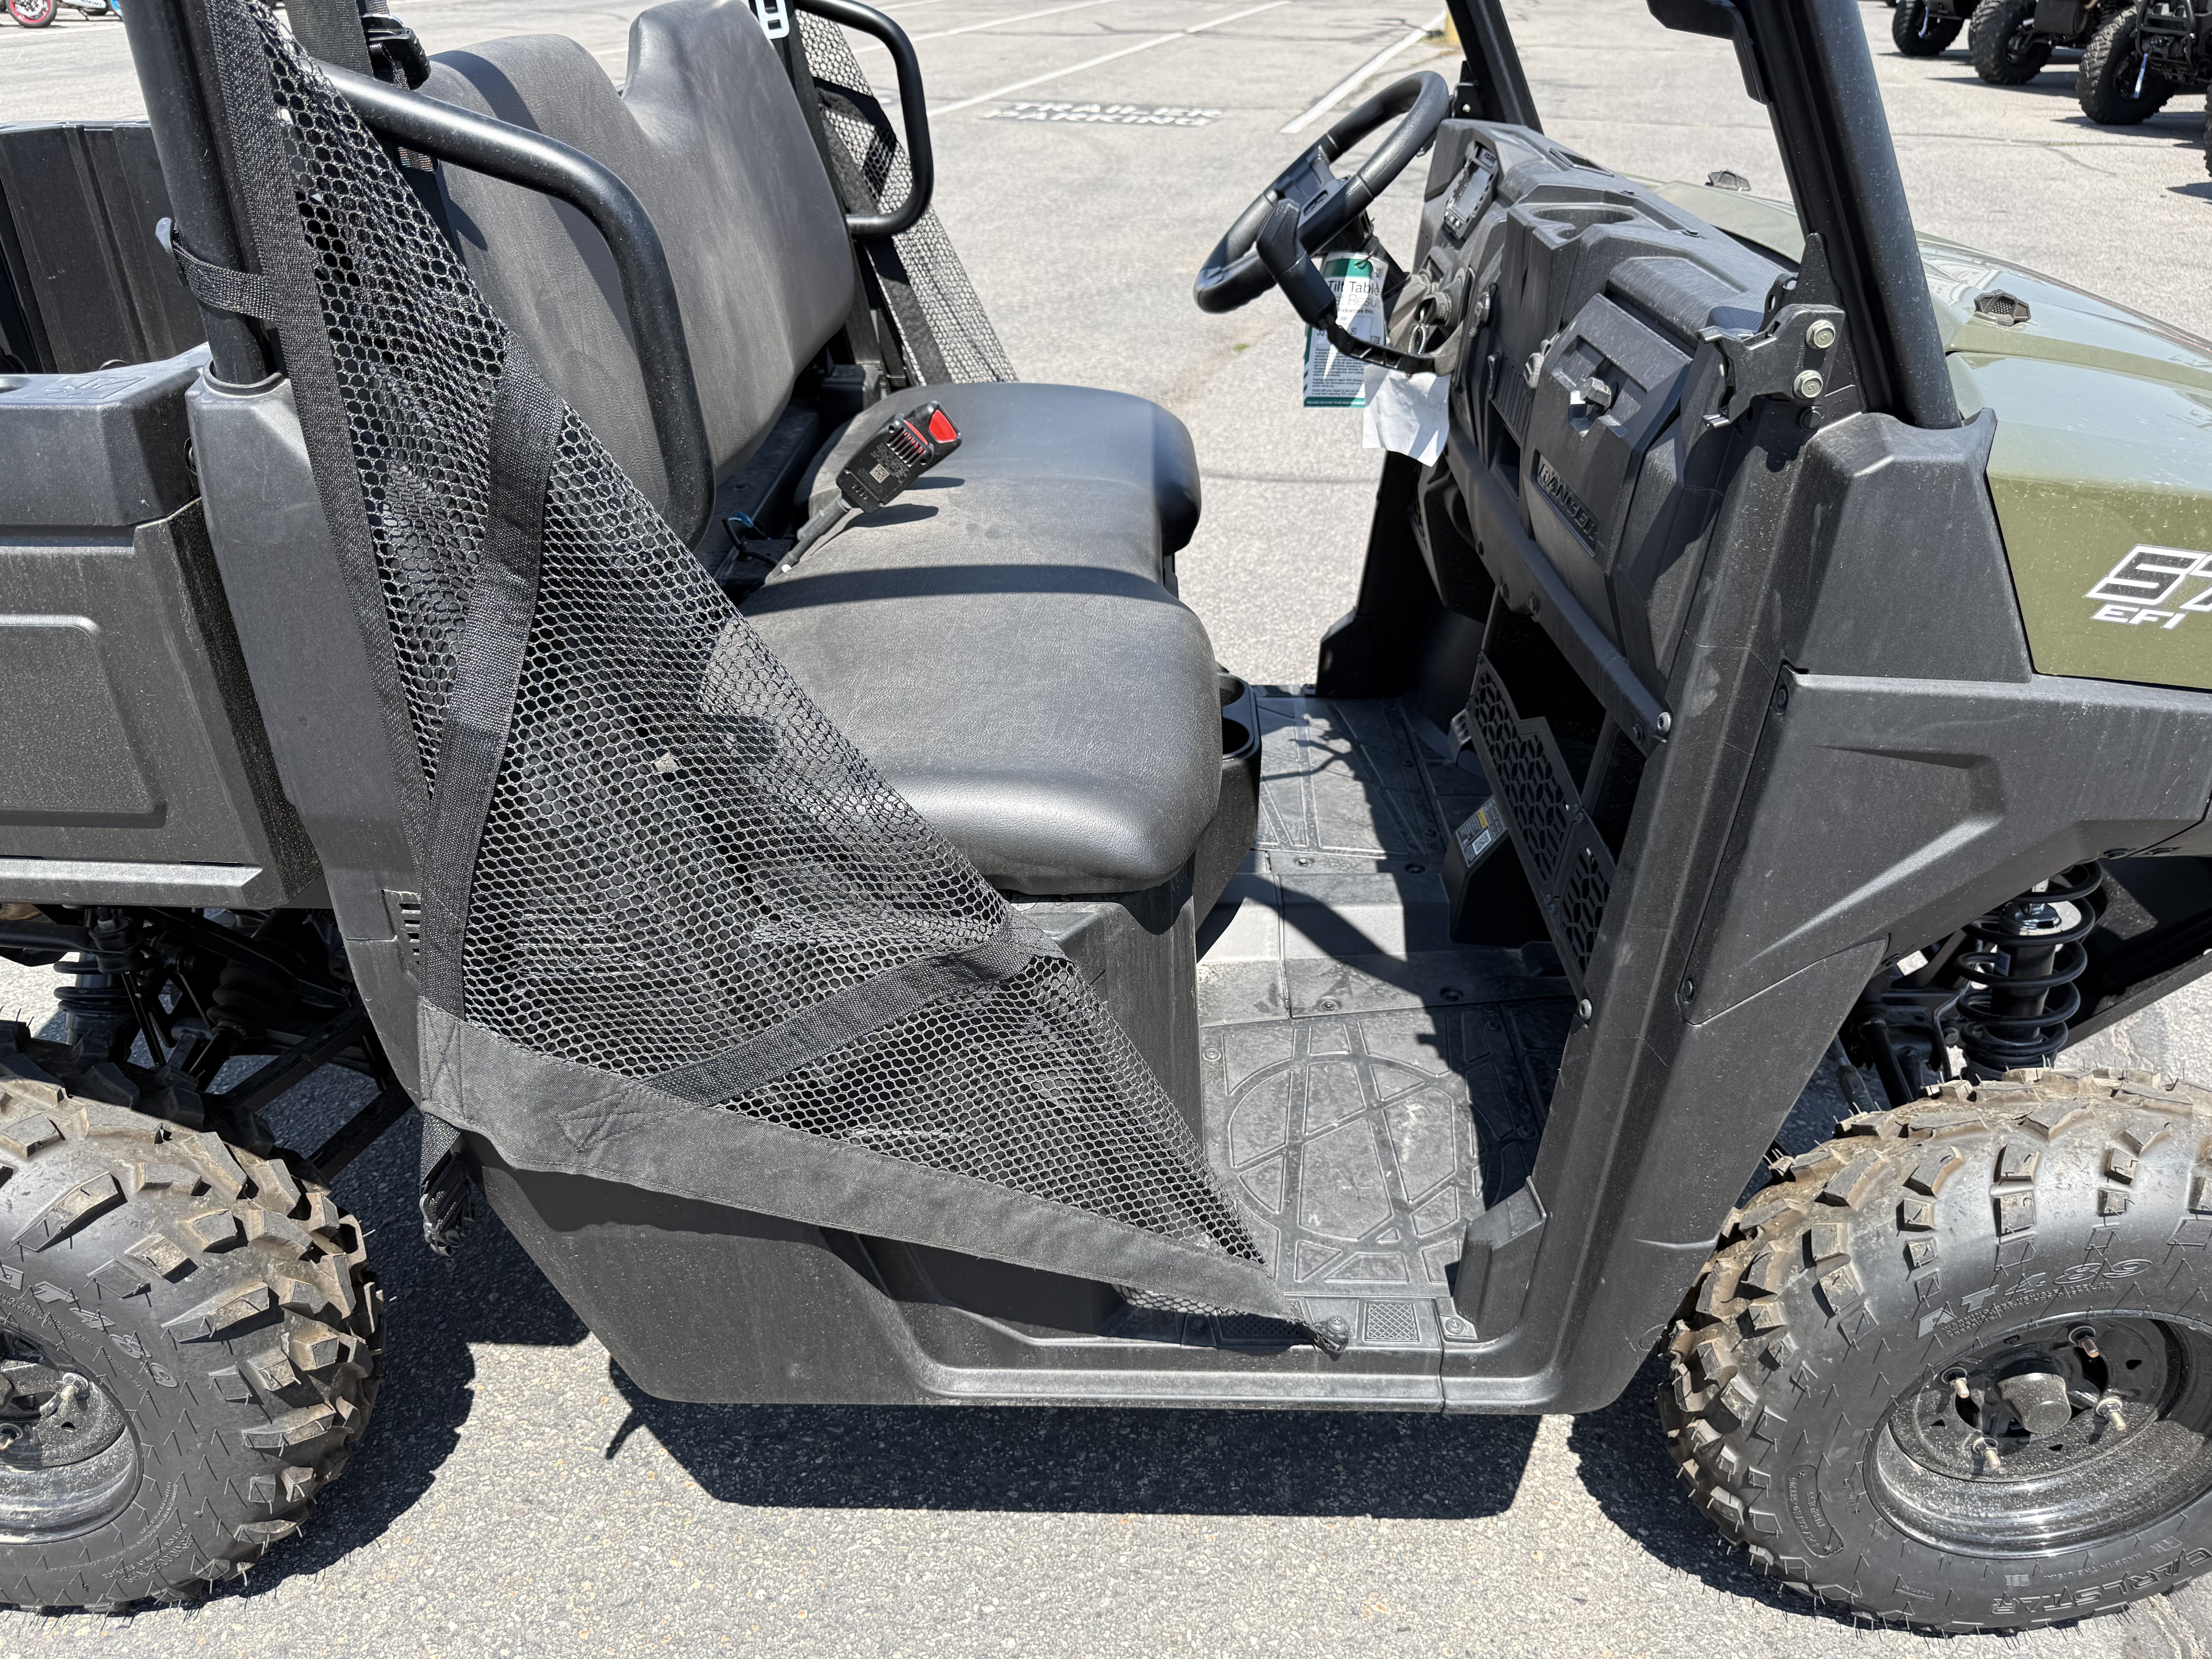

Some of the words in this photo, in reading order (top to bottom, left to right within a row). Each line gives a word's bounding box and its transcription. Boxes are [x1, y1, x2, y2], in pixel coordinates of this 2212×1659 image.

[1014, 101, 1224, 118] TRAILER
[1328, 280, 1344, 292] Tilt
[1349, 281, 1379, 295] Table
[1348, 294, 1381, 310] Result
[1538, 463, 1599, 541] RANGER
[2090, 603, 2187, 629] EFI
[165, 1535, 178, 1546] FOR
[1989, 1548, 2212, 1615] CARLSTAR
